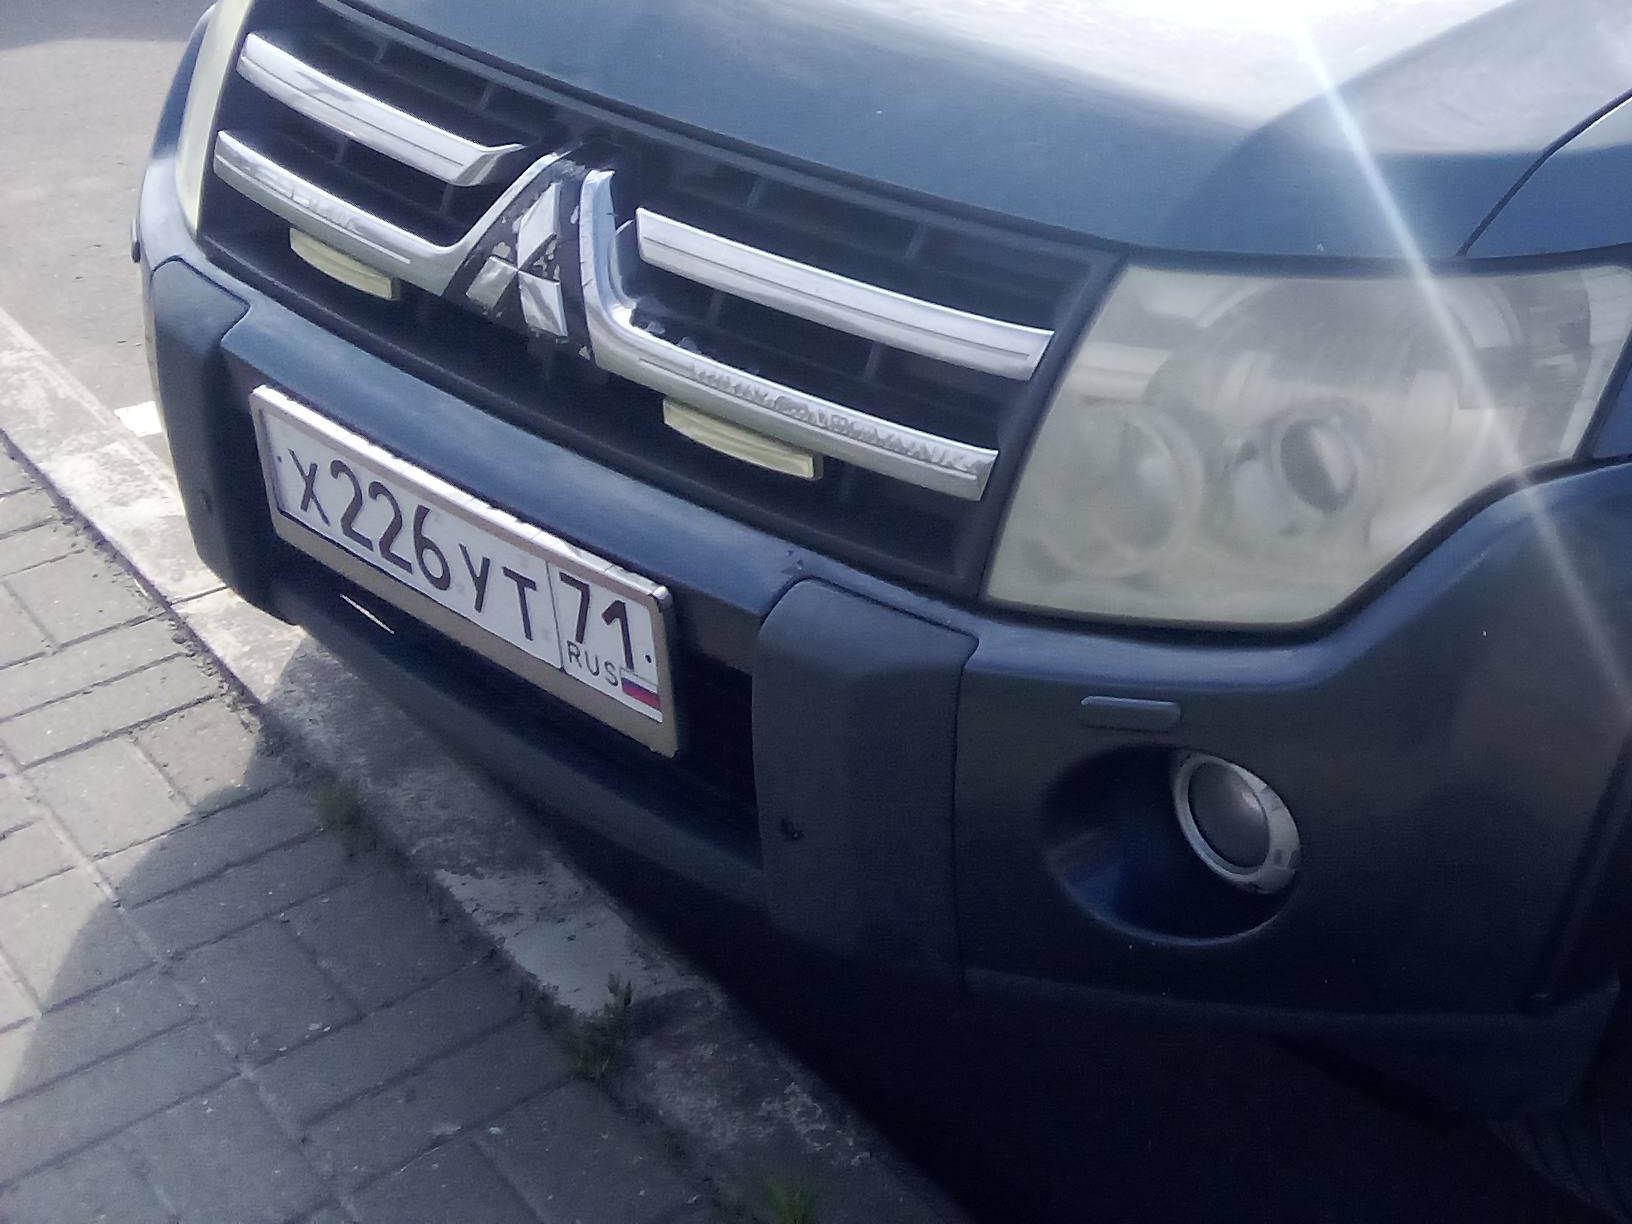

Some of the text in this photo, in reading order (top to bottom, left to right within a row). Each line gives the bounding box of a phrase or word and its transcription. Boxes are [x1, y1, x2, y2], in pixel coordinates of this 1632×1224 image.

[288, 448, 634, 670] Х226УТ 71
[567, 640, 619, 688] RUS
